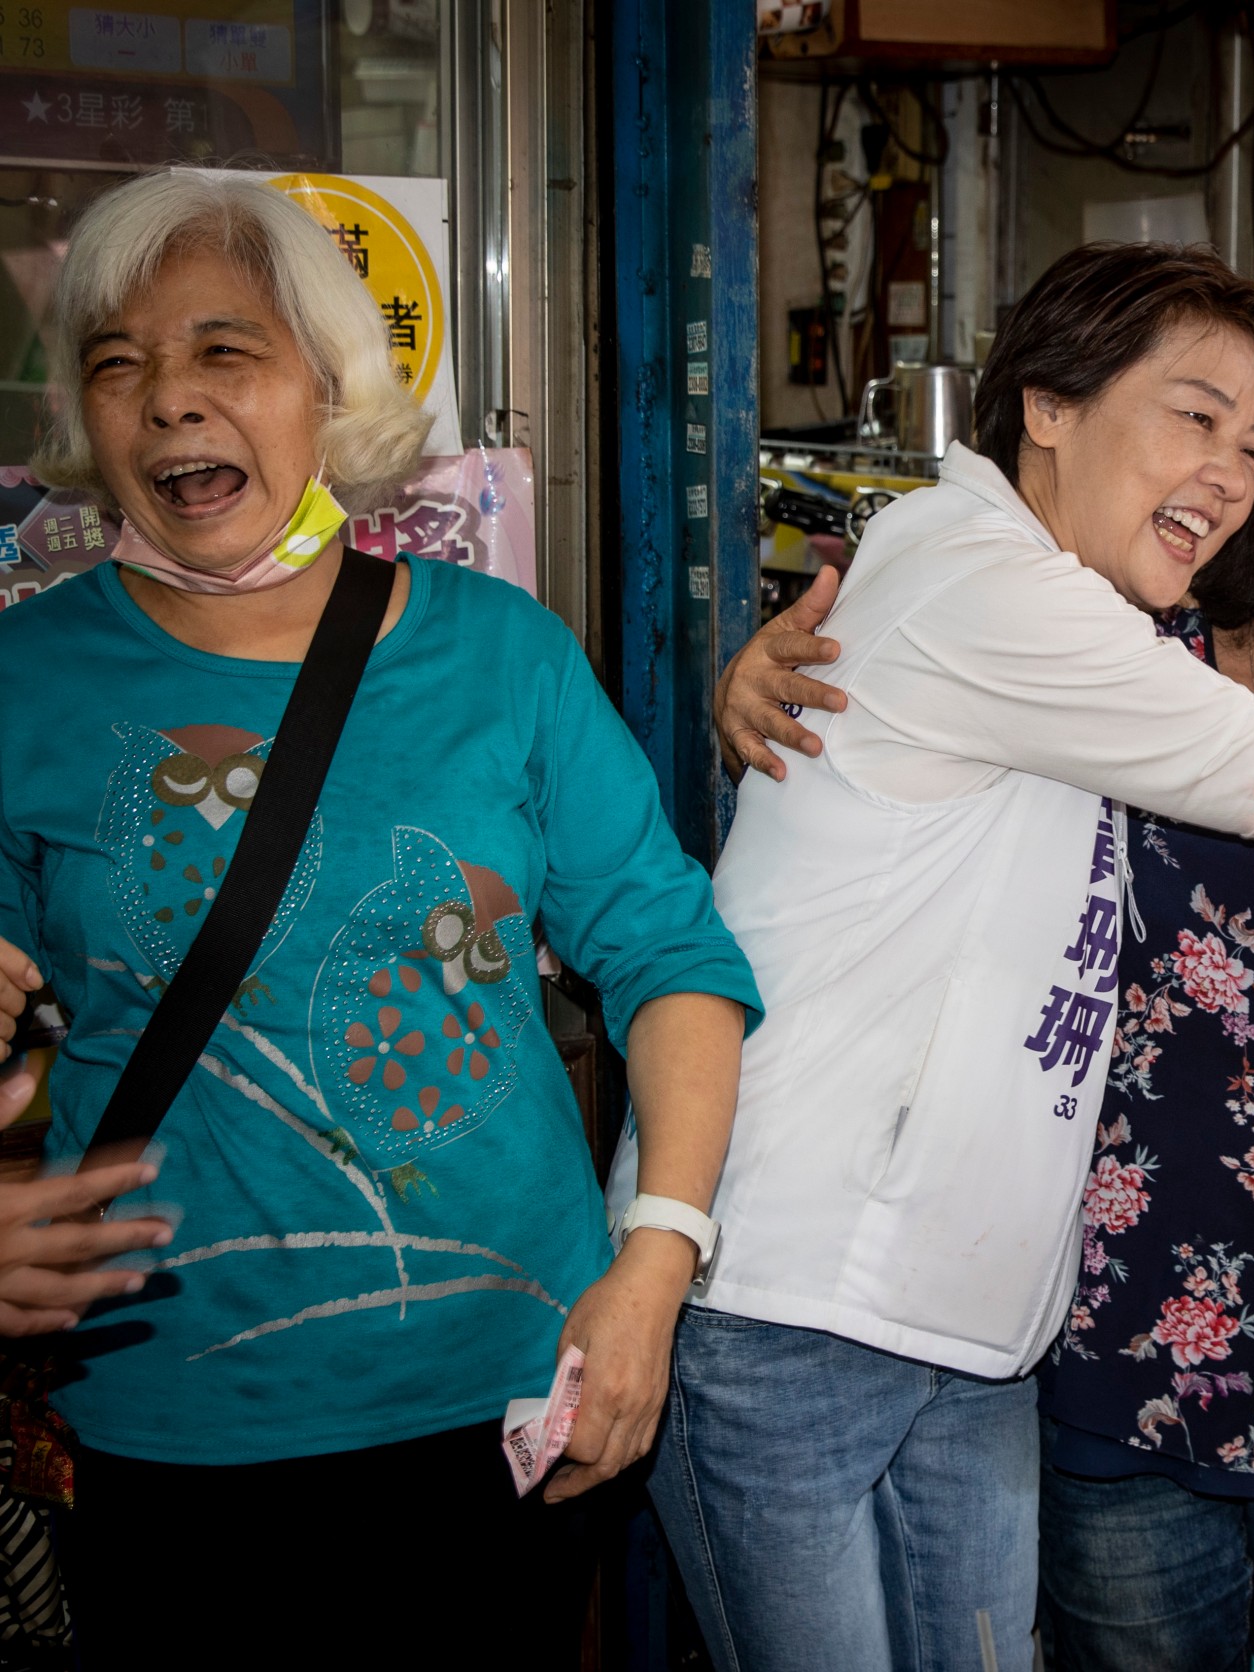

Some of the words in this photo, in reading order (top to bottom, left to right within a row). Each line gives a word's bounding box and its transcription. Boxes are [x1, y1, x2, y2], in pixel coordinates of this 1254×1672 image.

[43, 514, 75, 536] 週二
[47, 532, 79, 553] 週五
[1053, 1094, 1078, 1121] 33
